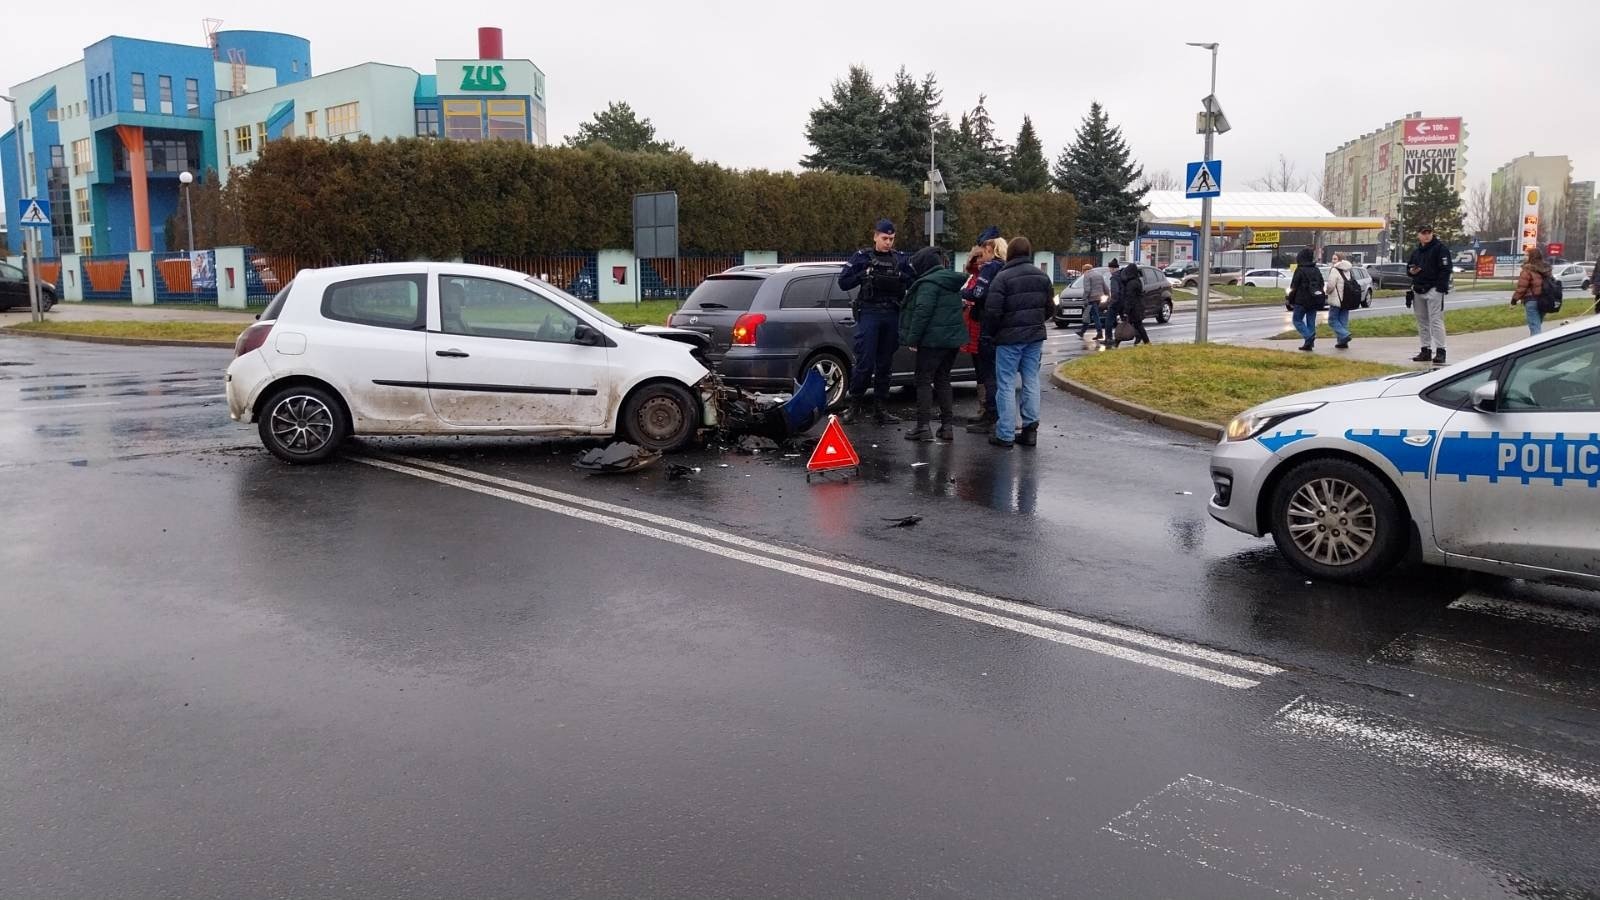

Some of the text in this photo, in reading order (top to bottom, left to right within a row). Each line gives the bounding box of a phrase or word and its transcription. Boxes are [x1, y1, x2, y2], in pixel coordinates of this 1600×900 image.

[460, 65, 507, 92] ZUS
[1405, 158, 1456, 175] NISKIE
[1404, 173, 1455, 196] CEY!
[1498, 442, 1599, 475] POLIC
